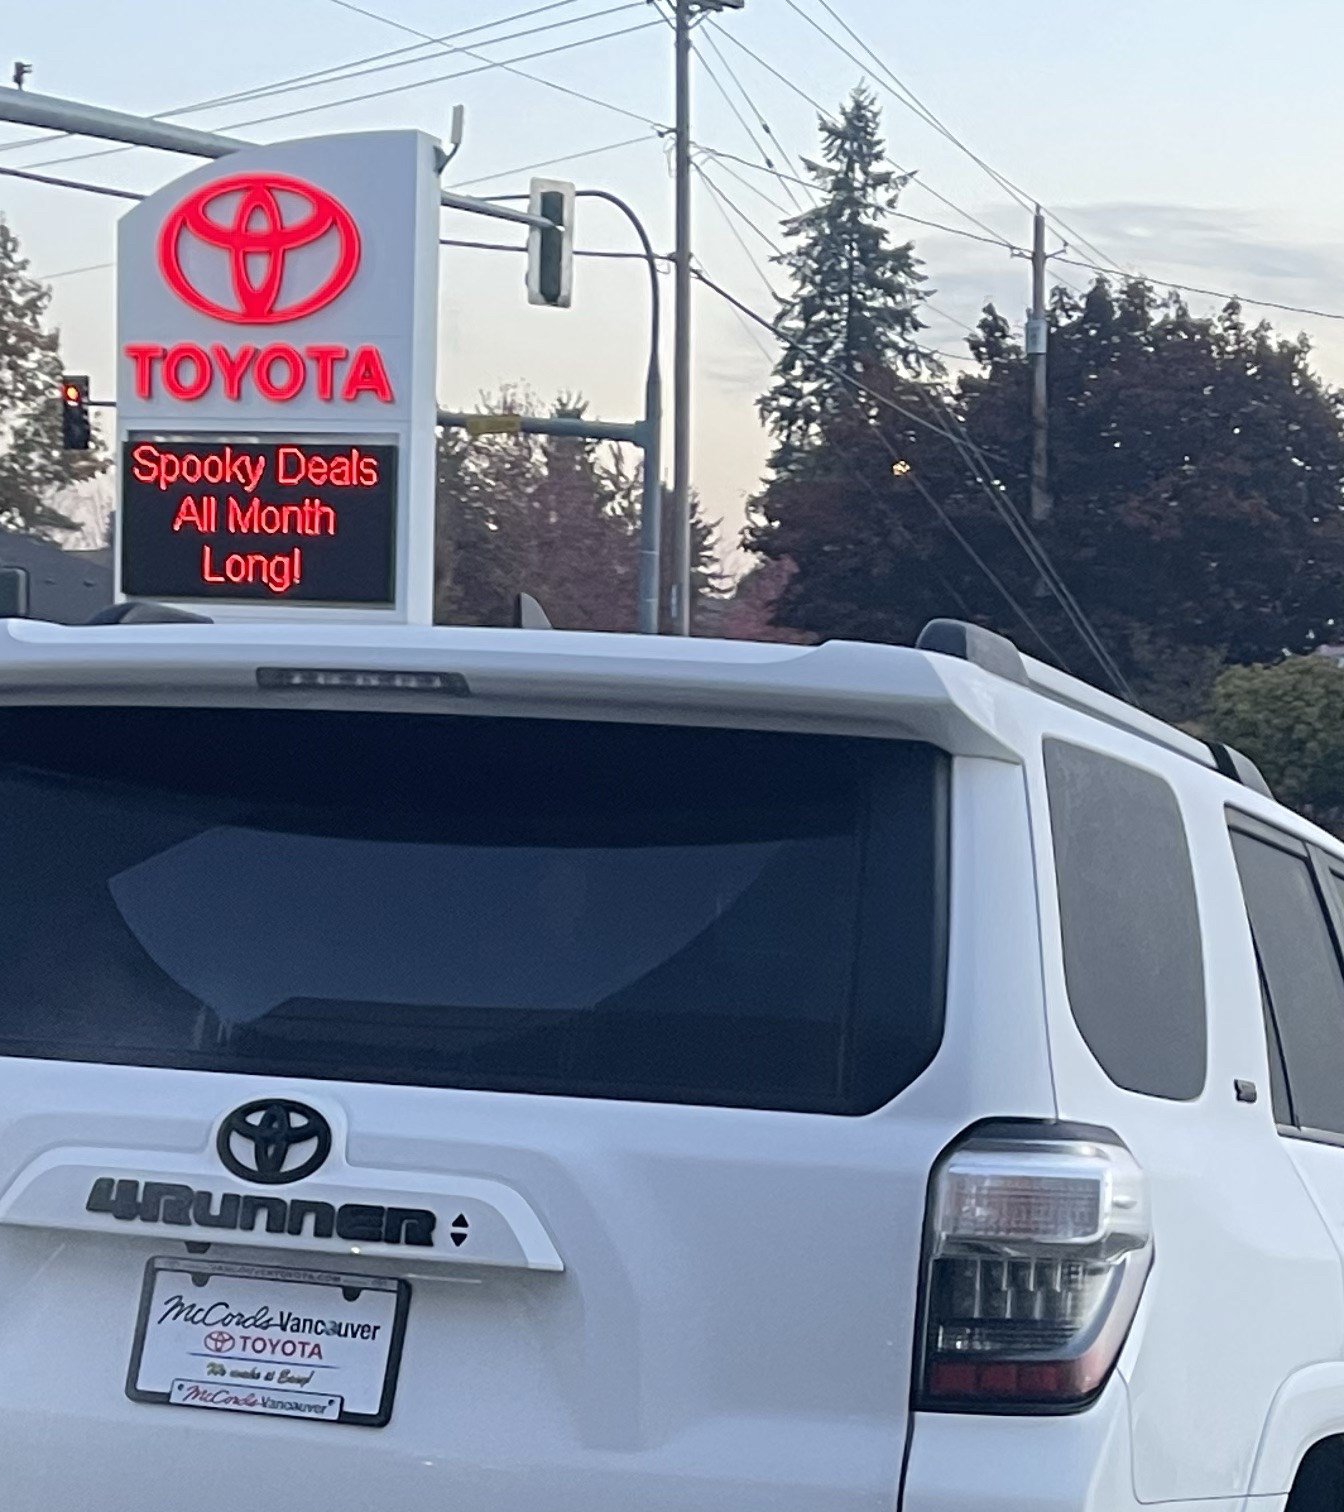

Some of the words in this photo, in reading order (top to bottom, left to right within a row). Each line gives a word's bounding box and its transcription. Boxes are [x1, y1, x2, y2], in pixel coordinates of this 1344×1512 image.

[122, 341, 394, 403] TOYOTA
[131, 444, 266, 493] Spooky
[277, 446, 379, 488] Deals
[173, 495, 217, 535] All
[227, 496, 337, 537] Month
[201, 544, 303, 594] Long!
[239, 1334, 323, 1360] TOYOTA
